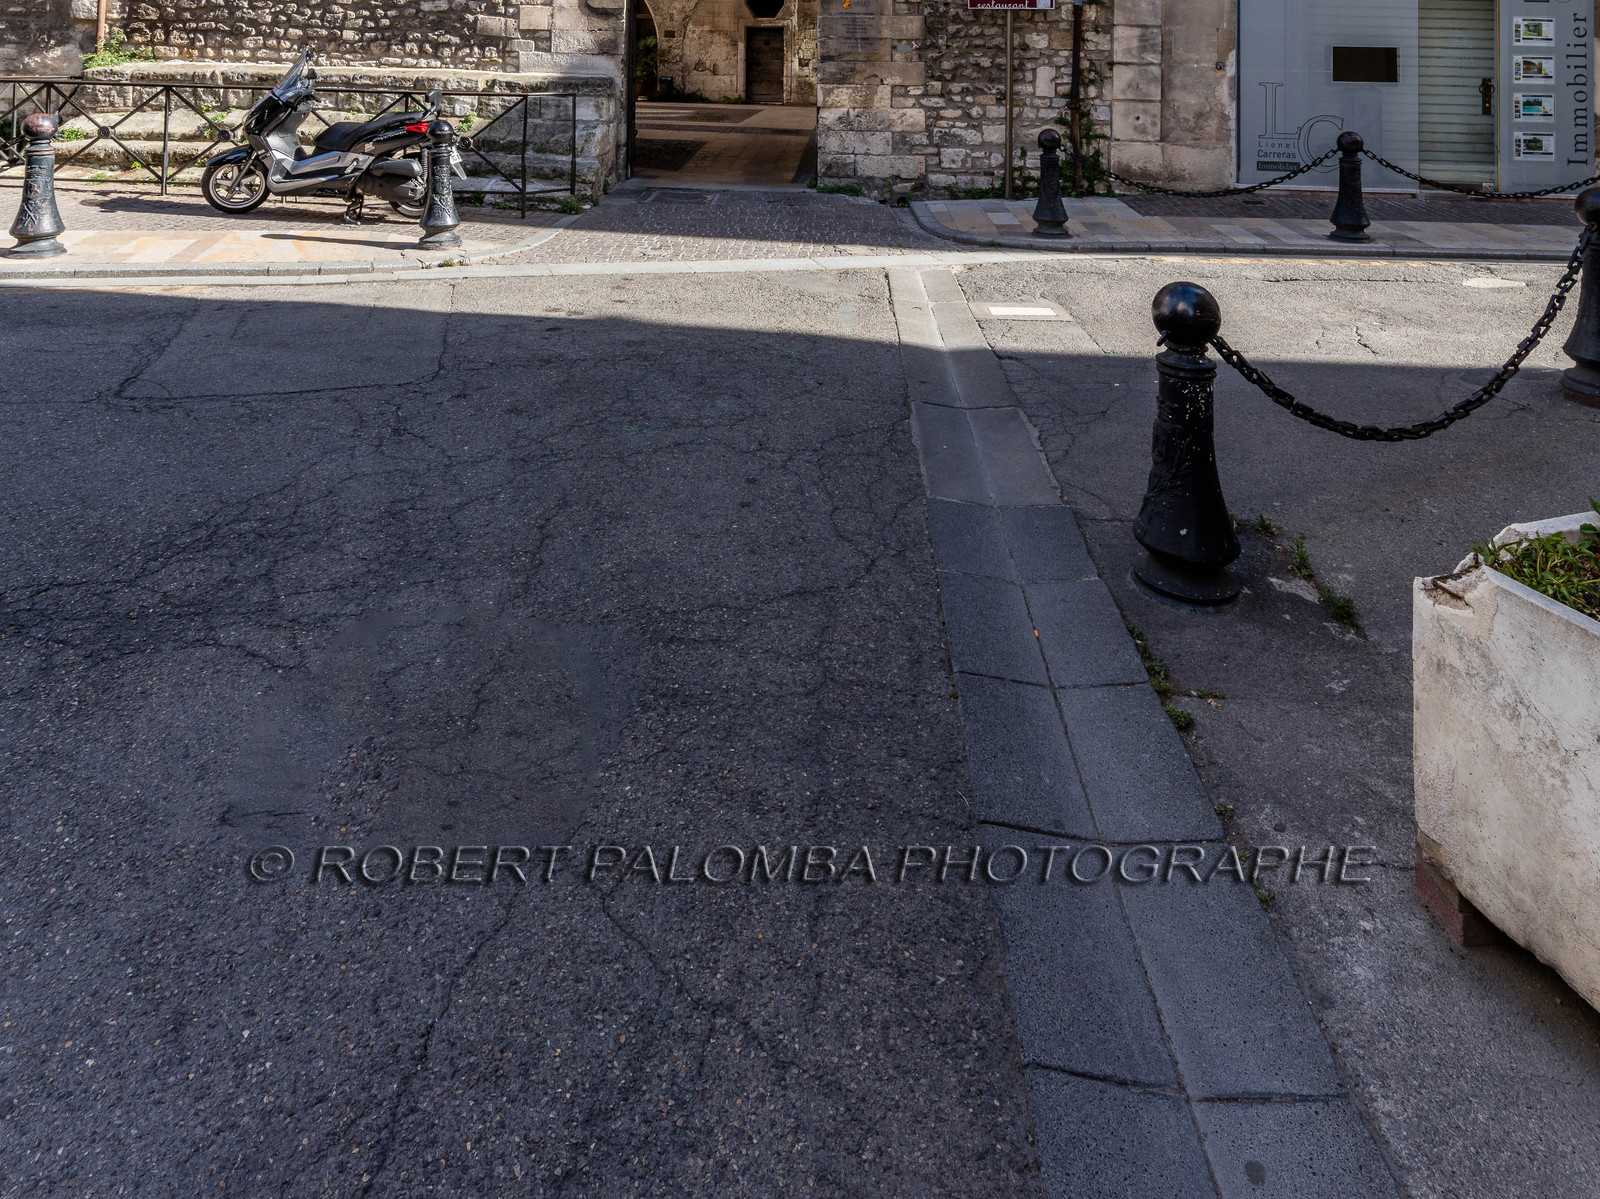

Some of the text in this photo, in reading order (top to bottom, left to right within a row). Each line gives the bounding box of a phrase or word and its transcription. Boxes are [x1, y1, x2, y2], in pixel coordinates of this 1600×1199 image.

[976, 0, 1030, 9] restaurant
[1566, 12, 1589, 167] Immobilier
[1258, 141, 1296, 149] Lionel
[1257, 149, 1297, 160] Carreras
